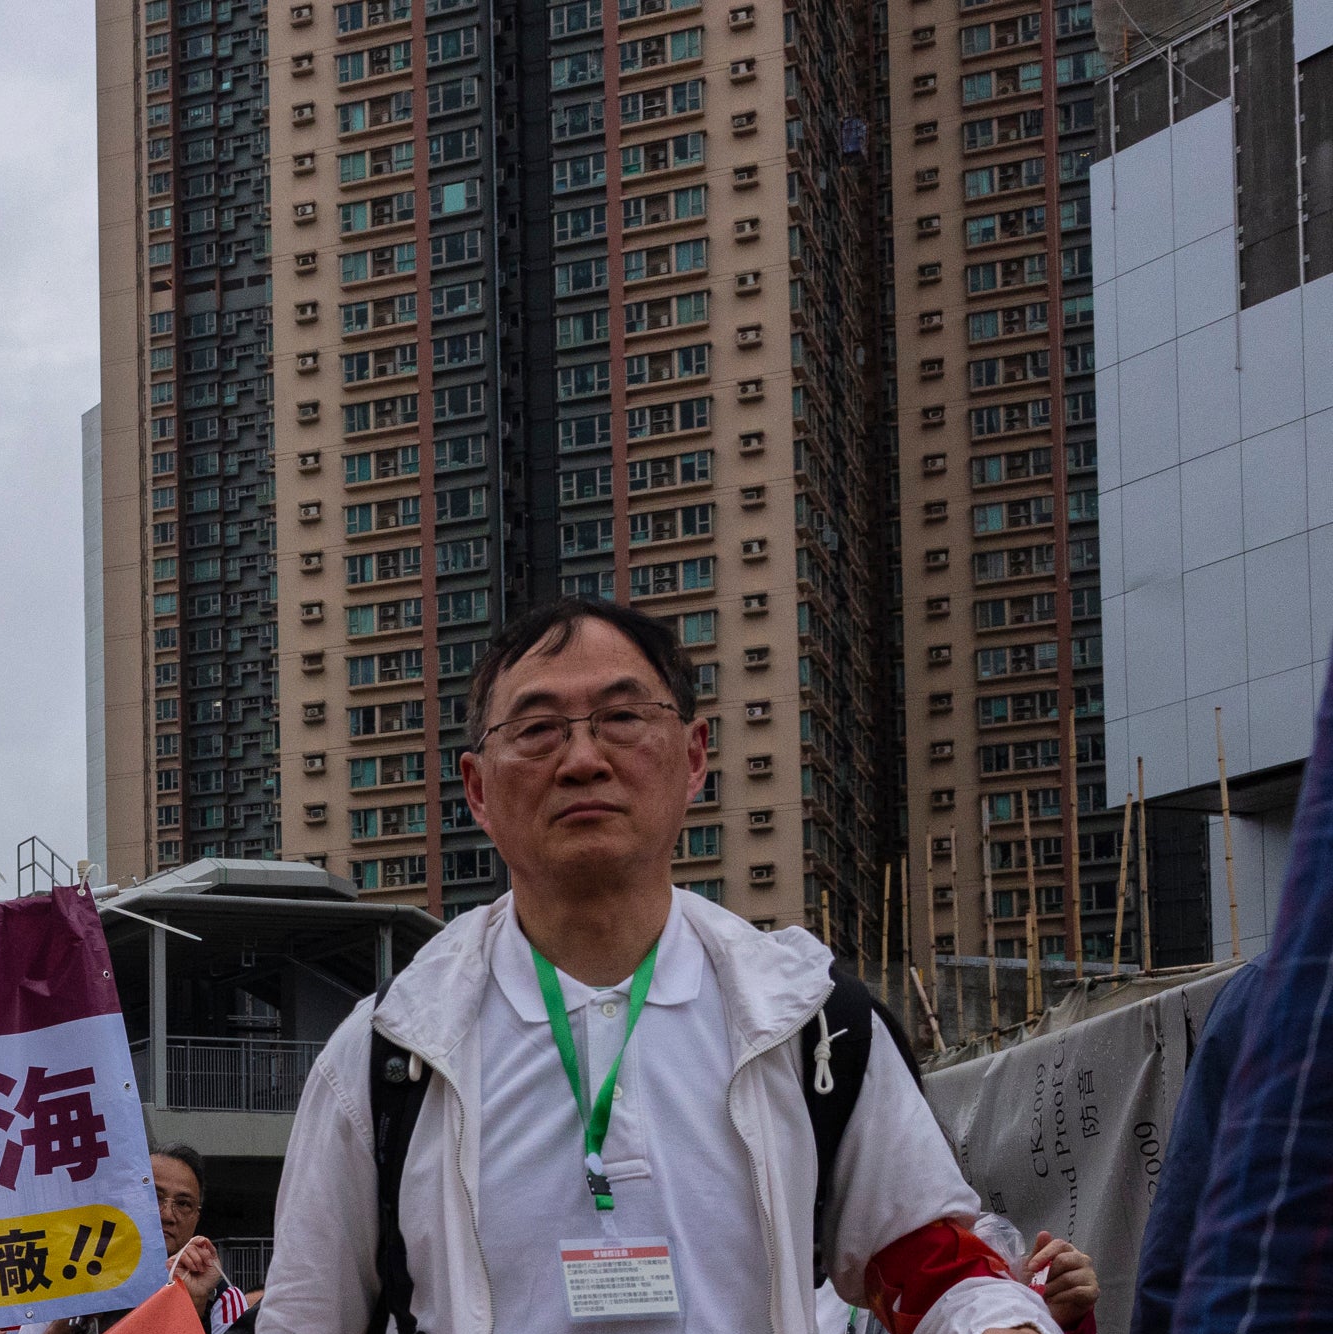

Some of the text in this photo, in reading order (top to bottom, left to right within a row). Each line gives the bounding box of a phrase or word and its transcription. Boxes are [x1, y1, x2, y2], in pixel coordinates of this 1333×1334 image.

[1030, 1063, 1049, 1178] CK2009
[1052, 1078, 1071, 1157] Proof
[1077, 1070, 1101, 1139] 防音
[1061, 1167, 1079, 1243] ound
